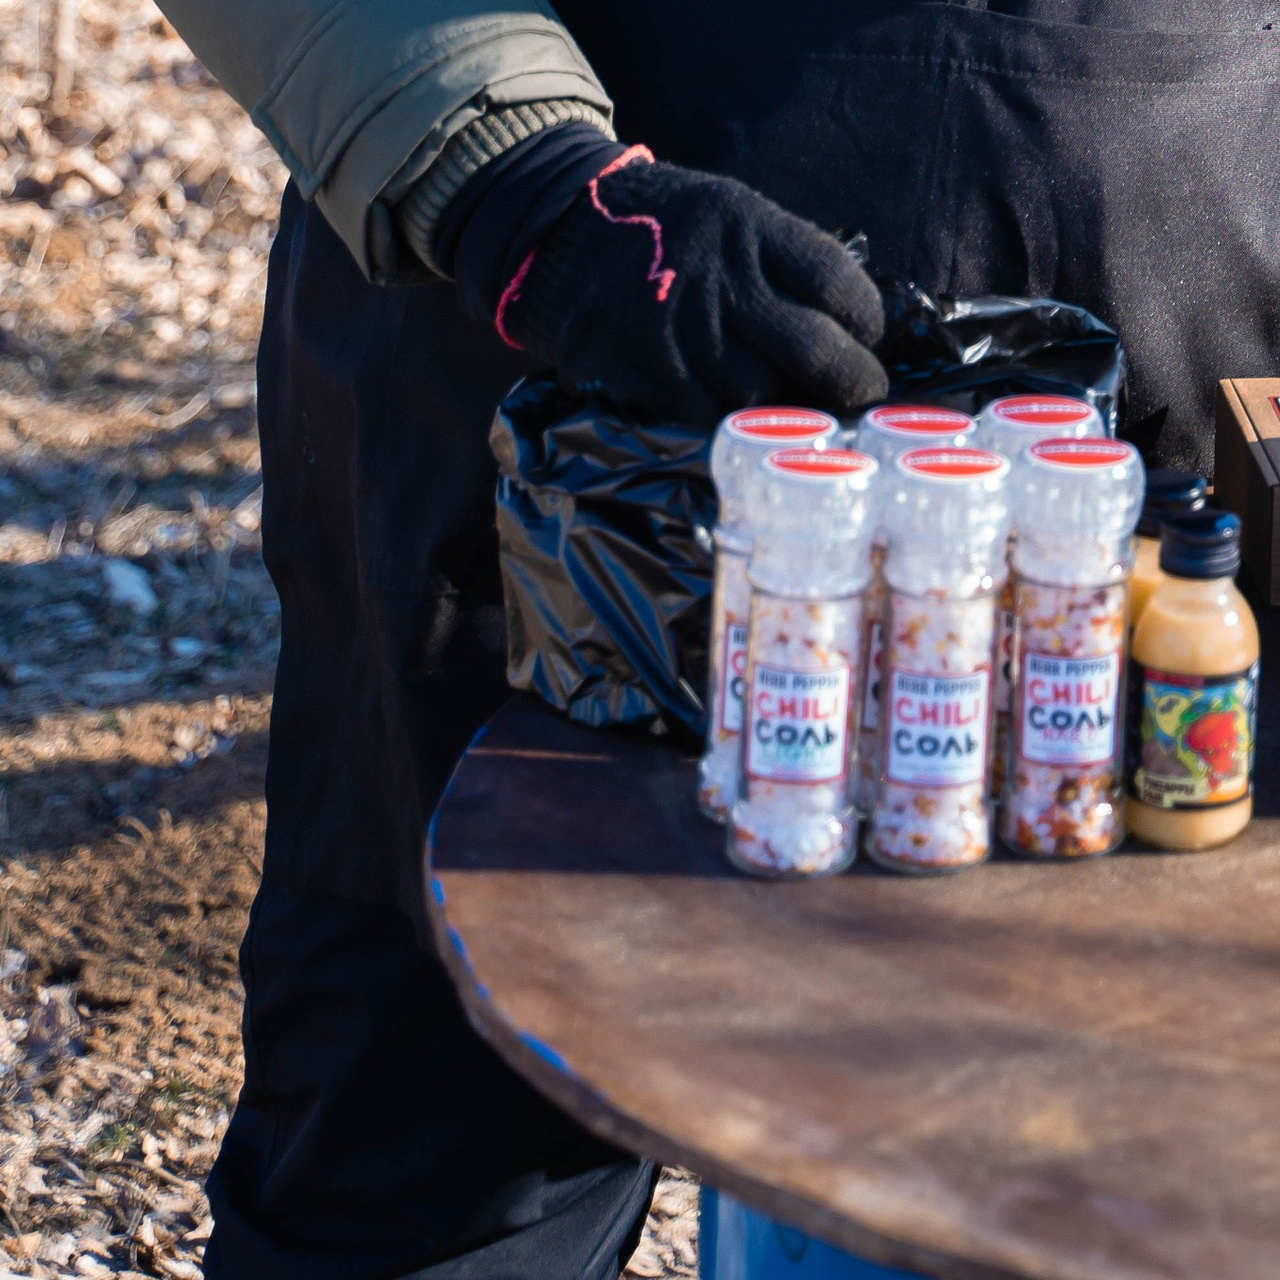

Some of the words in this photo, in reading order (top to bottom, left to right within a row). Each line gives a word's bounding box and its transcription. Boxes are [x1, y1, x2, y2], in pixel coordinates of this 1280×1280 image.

[756, 691, 838, 721] CHILI
[1028, 678, 1110, 706] CHILI
[895, 697, 980, 728] CHILI
